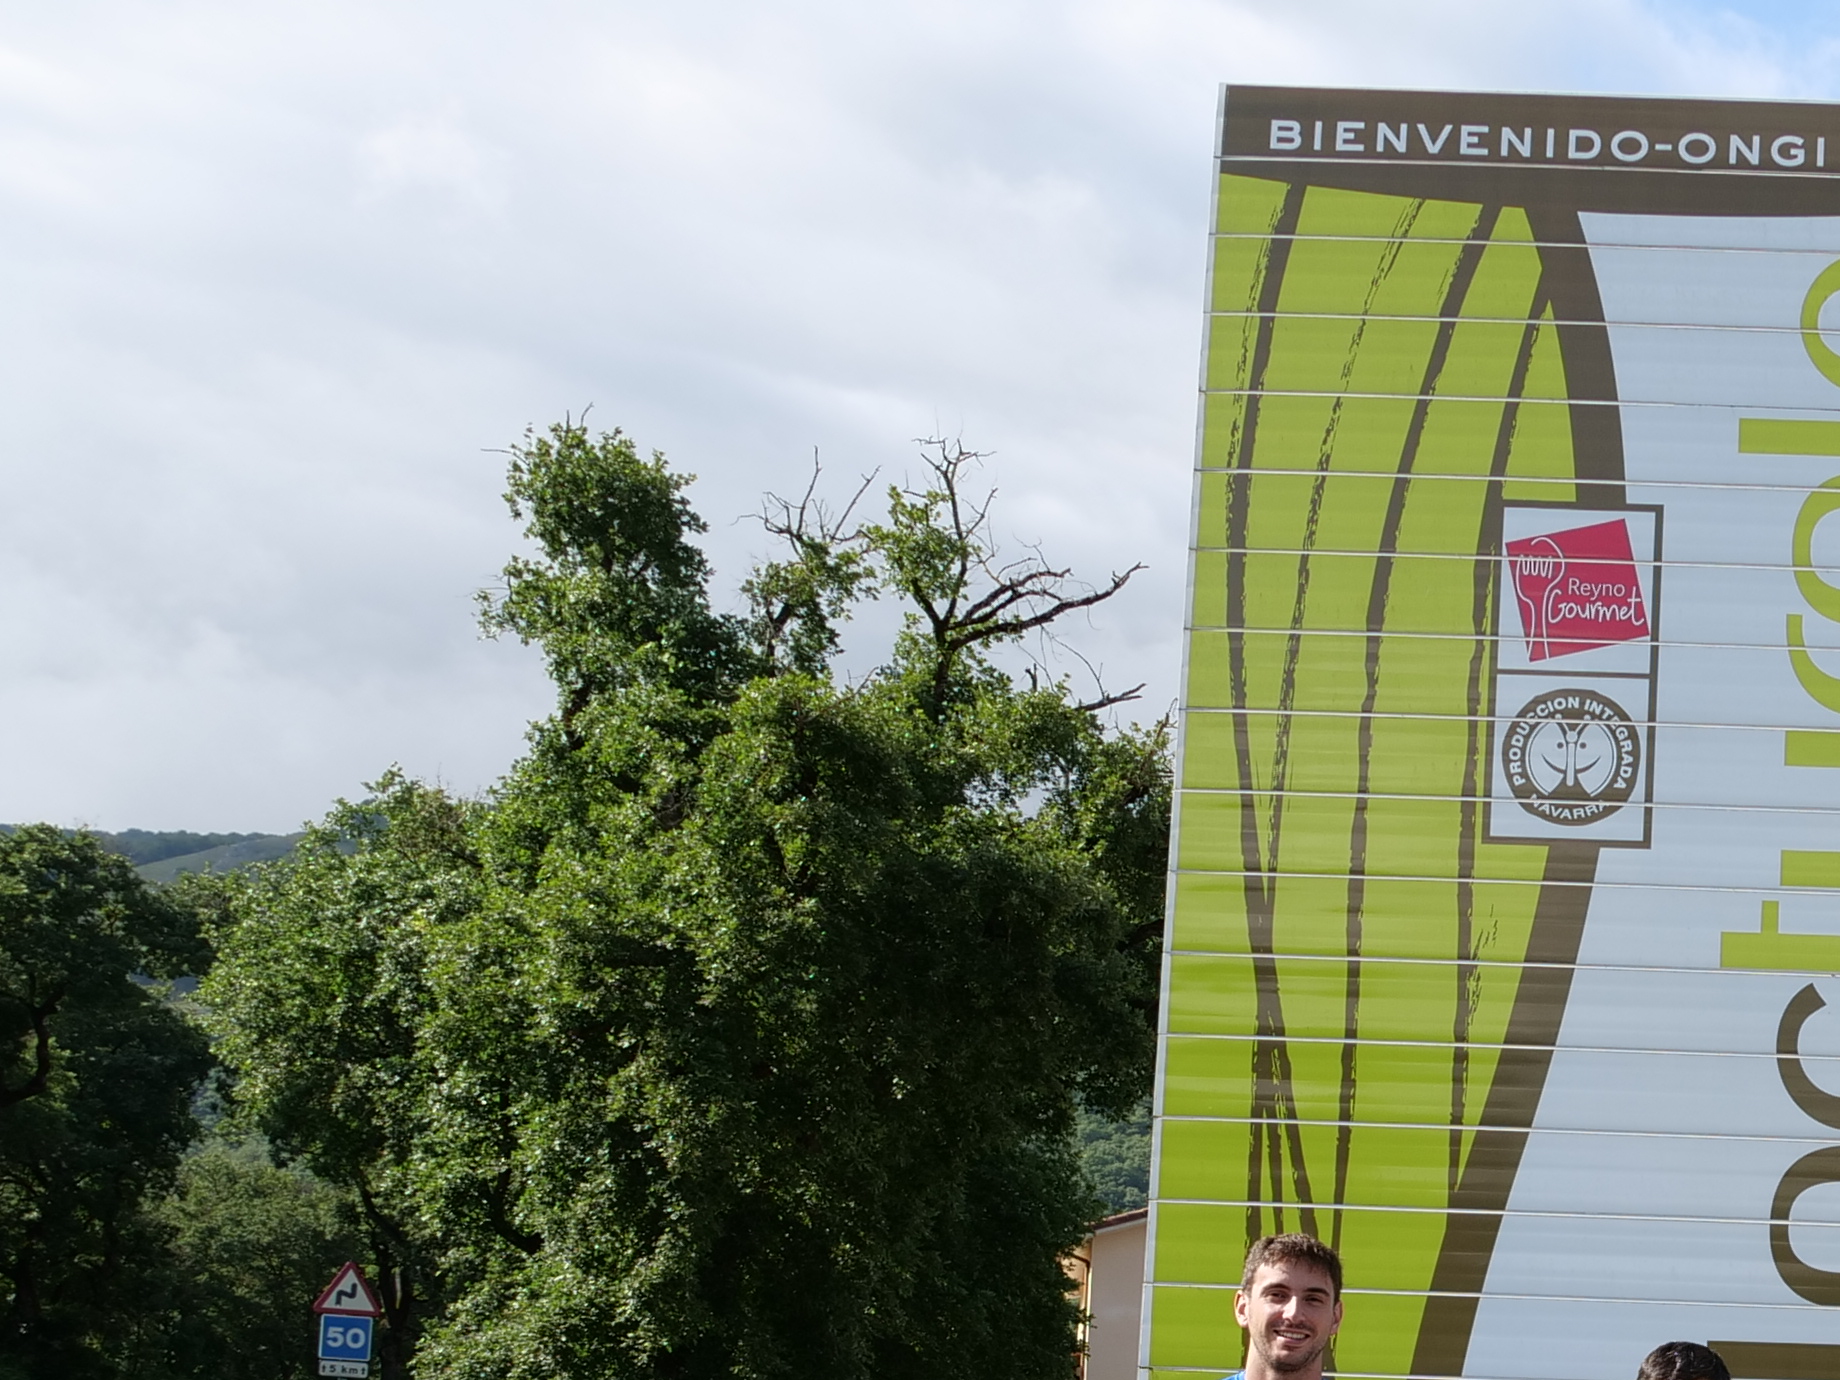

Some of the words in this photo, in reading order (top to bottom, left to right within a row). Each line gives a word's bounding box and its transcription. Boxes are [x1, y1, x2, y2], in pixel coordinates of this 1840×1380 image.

[1267, 118, 1826, 169] BIENVENIDO-ONGI
[1567, 577, 1626, 601] Reyno
[1547, 586, 1646, 626] Gourmet
[1583, 698, 1634, 790] INTEGRADA
[326, 1326, 367, 1349] 50
[329, 1364, 337, 1374] 5
[341, 1365, 359, 1375] km
